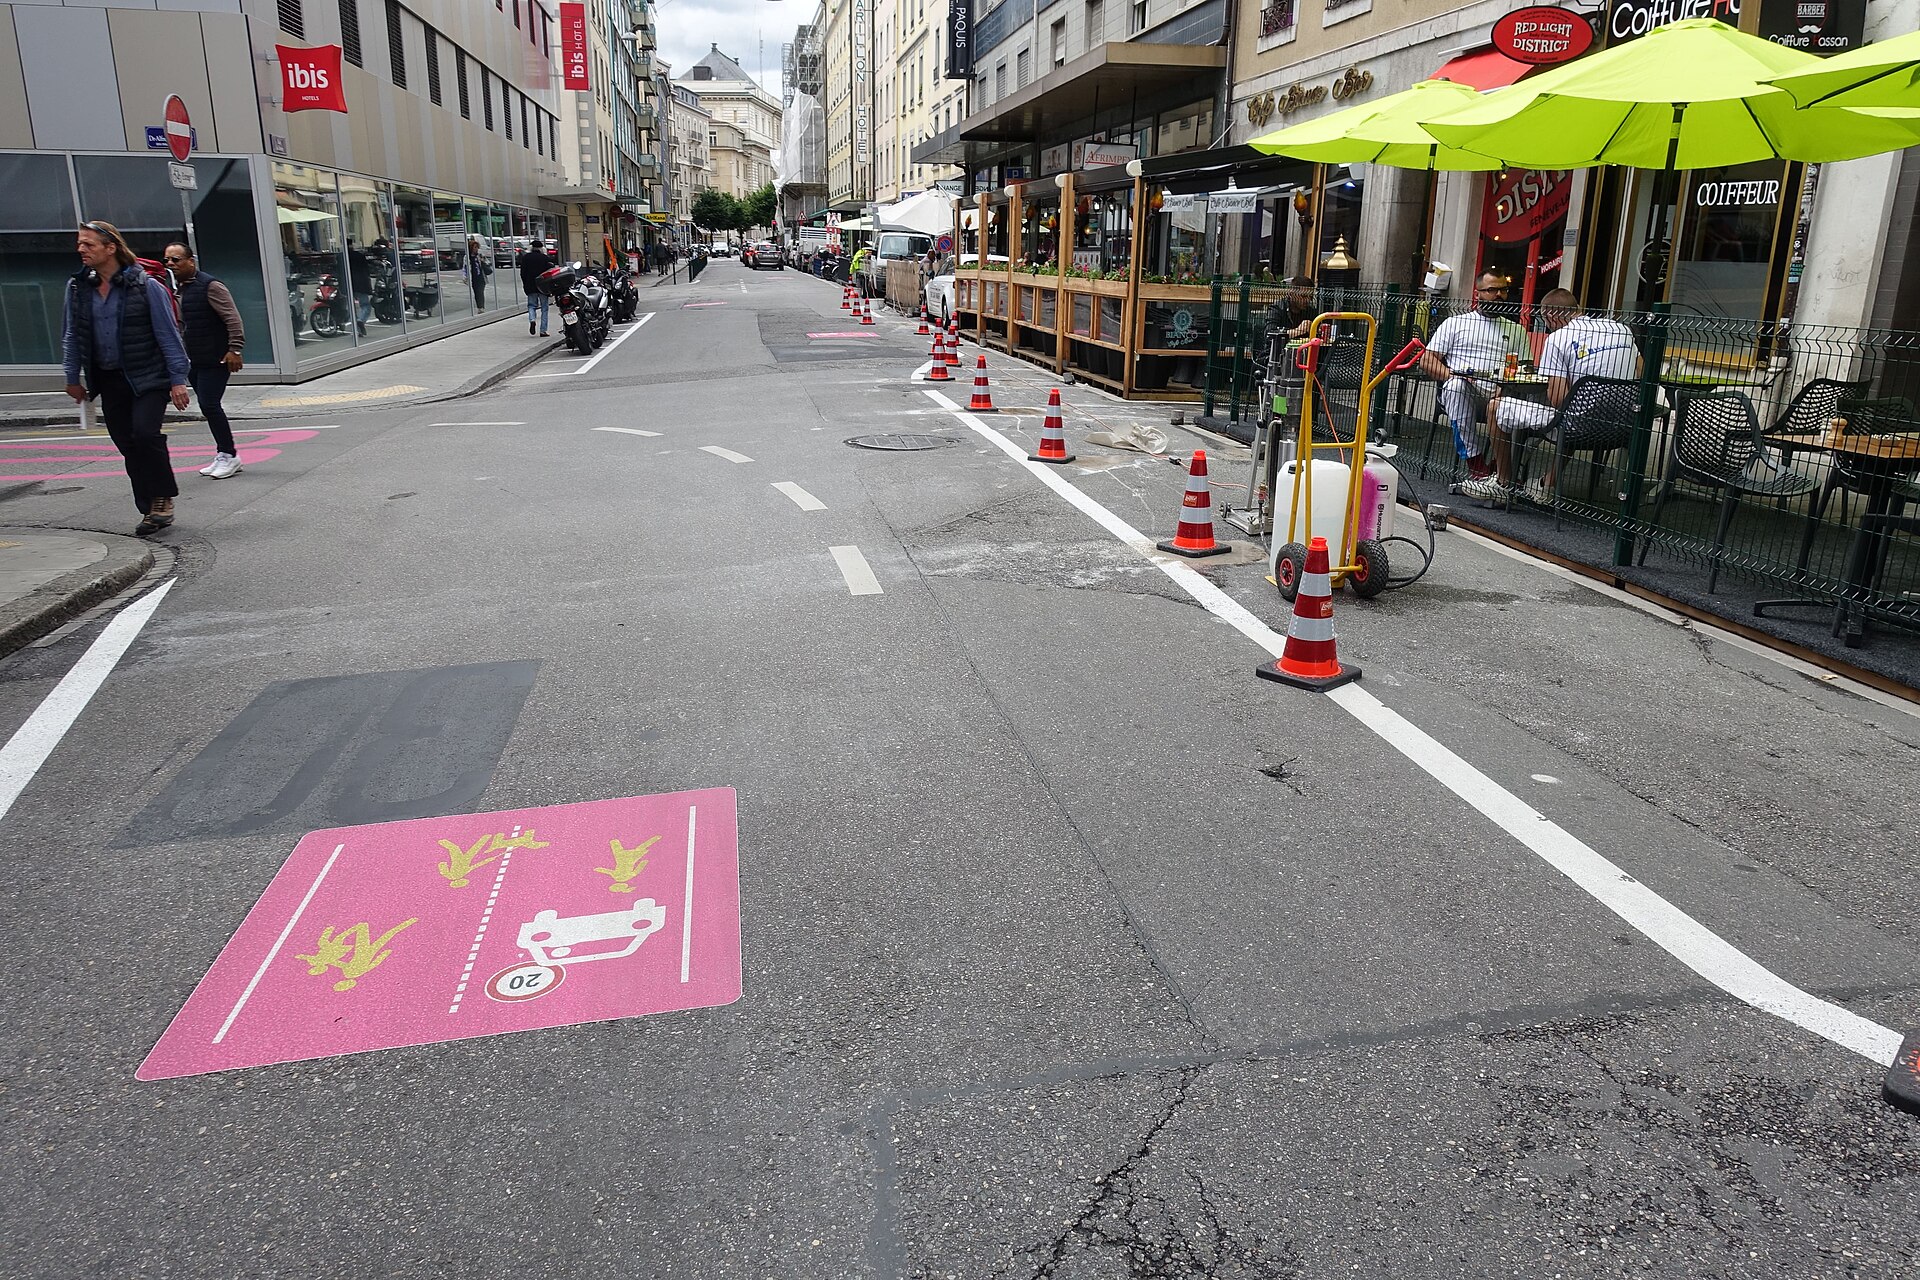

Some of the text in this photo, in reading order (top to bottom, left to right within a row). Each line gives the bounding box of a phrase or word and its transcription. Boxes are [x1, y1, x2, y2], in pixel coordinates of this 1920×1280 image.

[1797, 5, 1826, 15] BARBER
[955, 7, 967, 48] PAQUIS
[1514, 22, 1573, 38] RED LIGHT
[571, 19, 585, 78] ibis HOTEL
[1513, 38, 1570, 53] DISTRICT
[1768, 34, 1849, 47] Coiffure Hassan
[287, 63, 329, 89] ibis
[857, 106, 866, 163] HOTEL
[1697, 180, 1780, 206] COIFFEUR
[1165, 331, 1198, 339] BIANCO
[509, 972, 543, 990] 20
